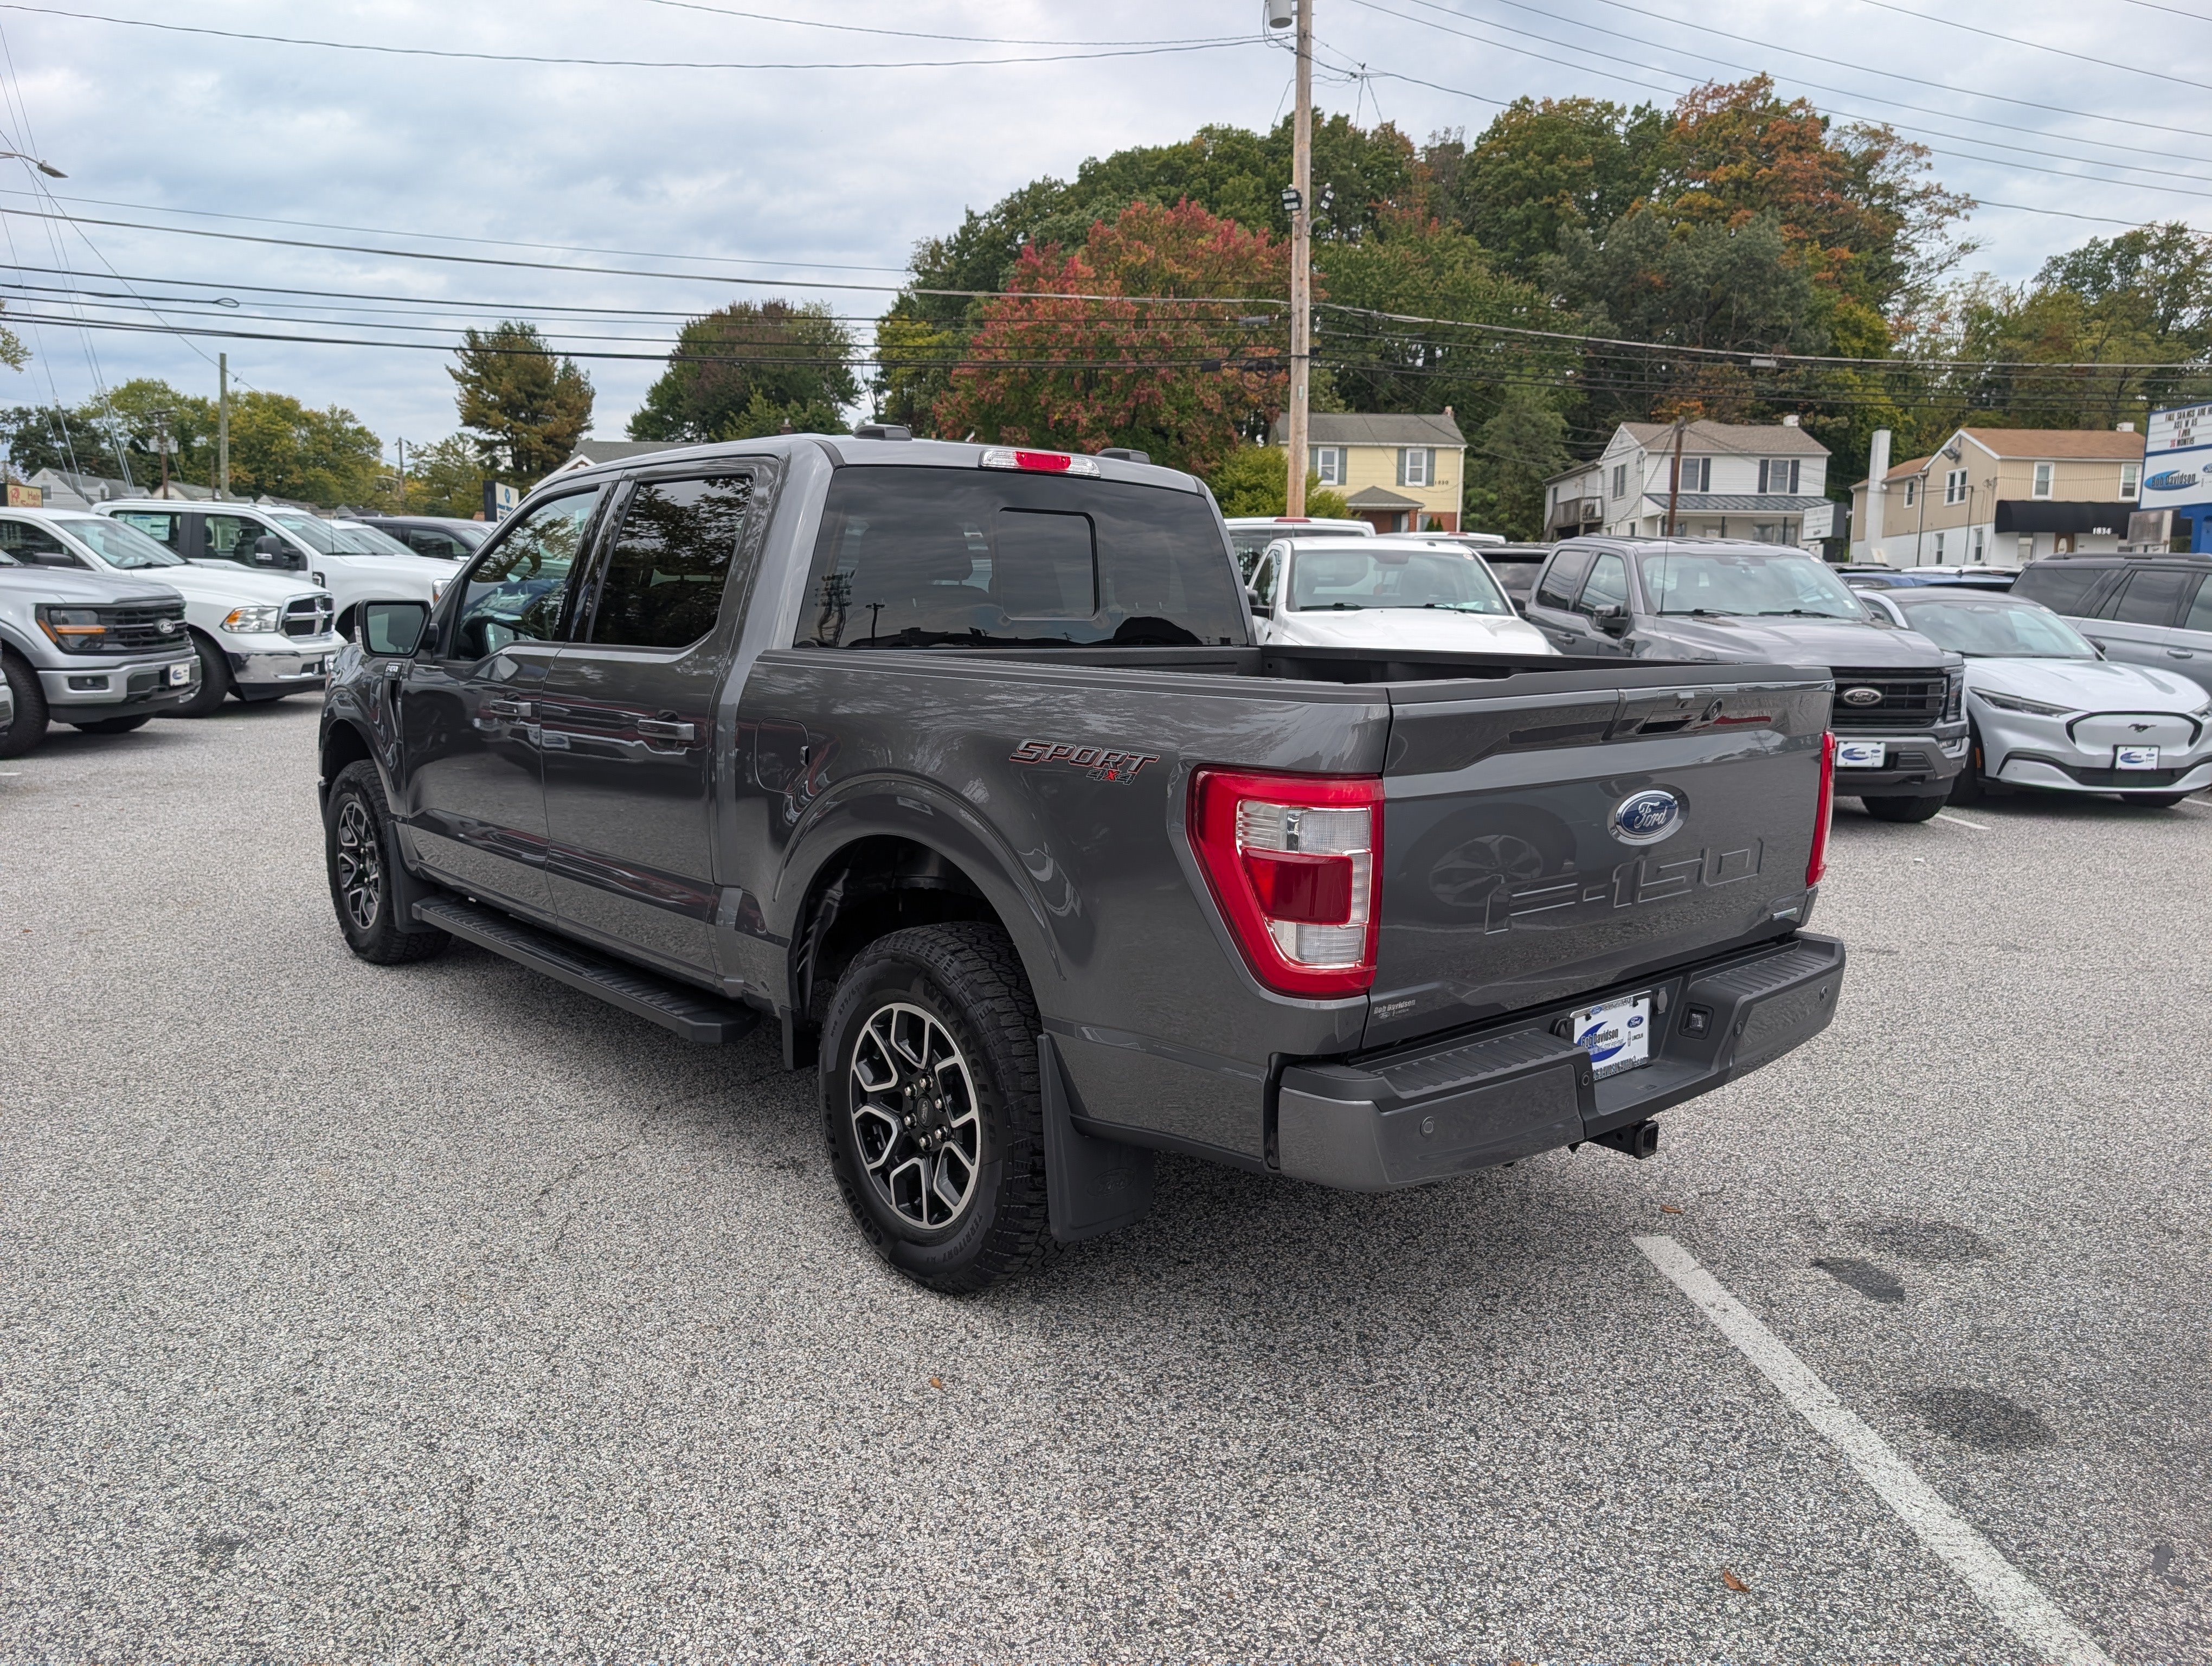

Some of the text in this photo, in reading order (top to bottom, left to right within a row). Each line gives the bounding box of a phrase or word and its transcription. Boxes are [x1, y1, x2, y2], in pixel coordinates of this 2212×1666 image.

[2151, 472, 2196, 487] Bob Davidson
[2093, 527, 2112, 535] 1834
[1009, 739, 1160, 774] SPORT
[1634, 801, 1668, 829] Ford
[1484, 838, 1763, 935] F-150
[1374, 999, 1416, 1015] Bob Davidson
[1581, 1034, 1593, 1048] Bob
[1593, 1028, 1619, 1045] Davidson
[1631, 1033, 1644, 1041] LINCOLN
